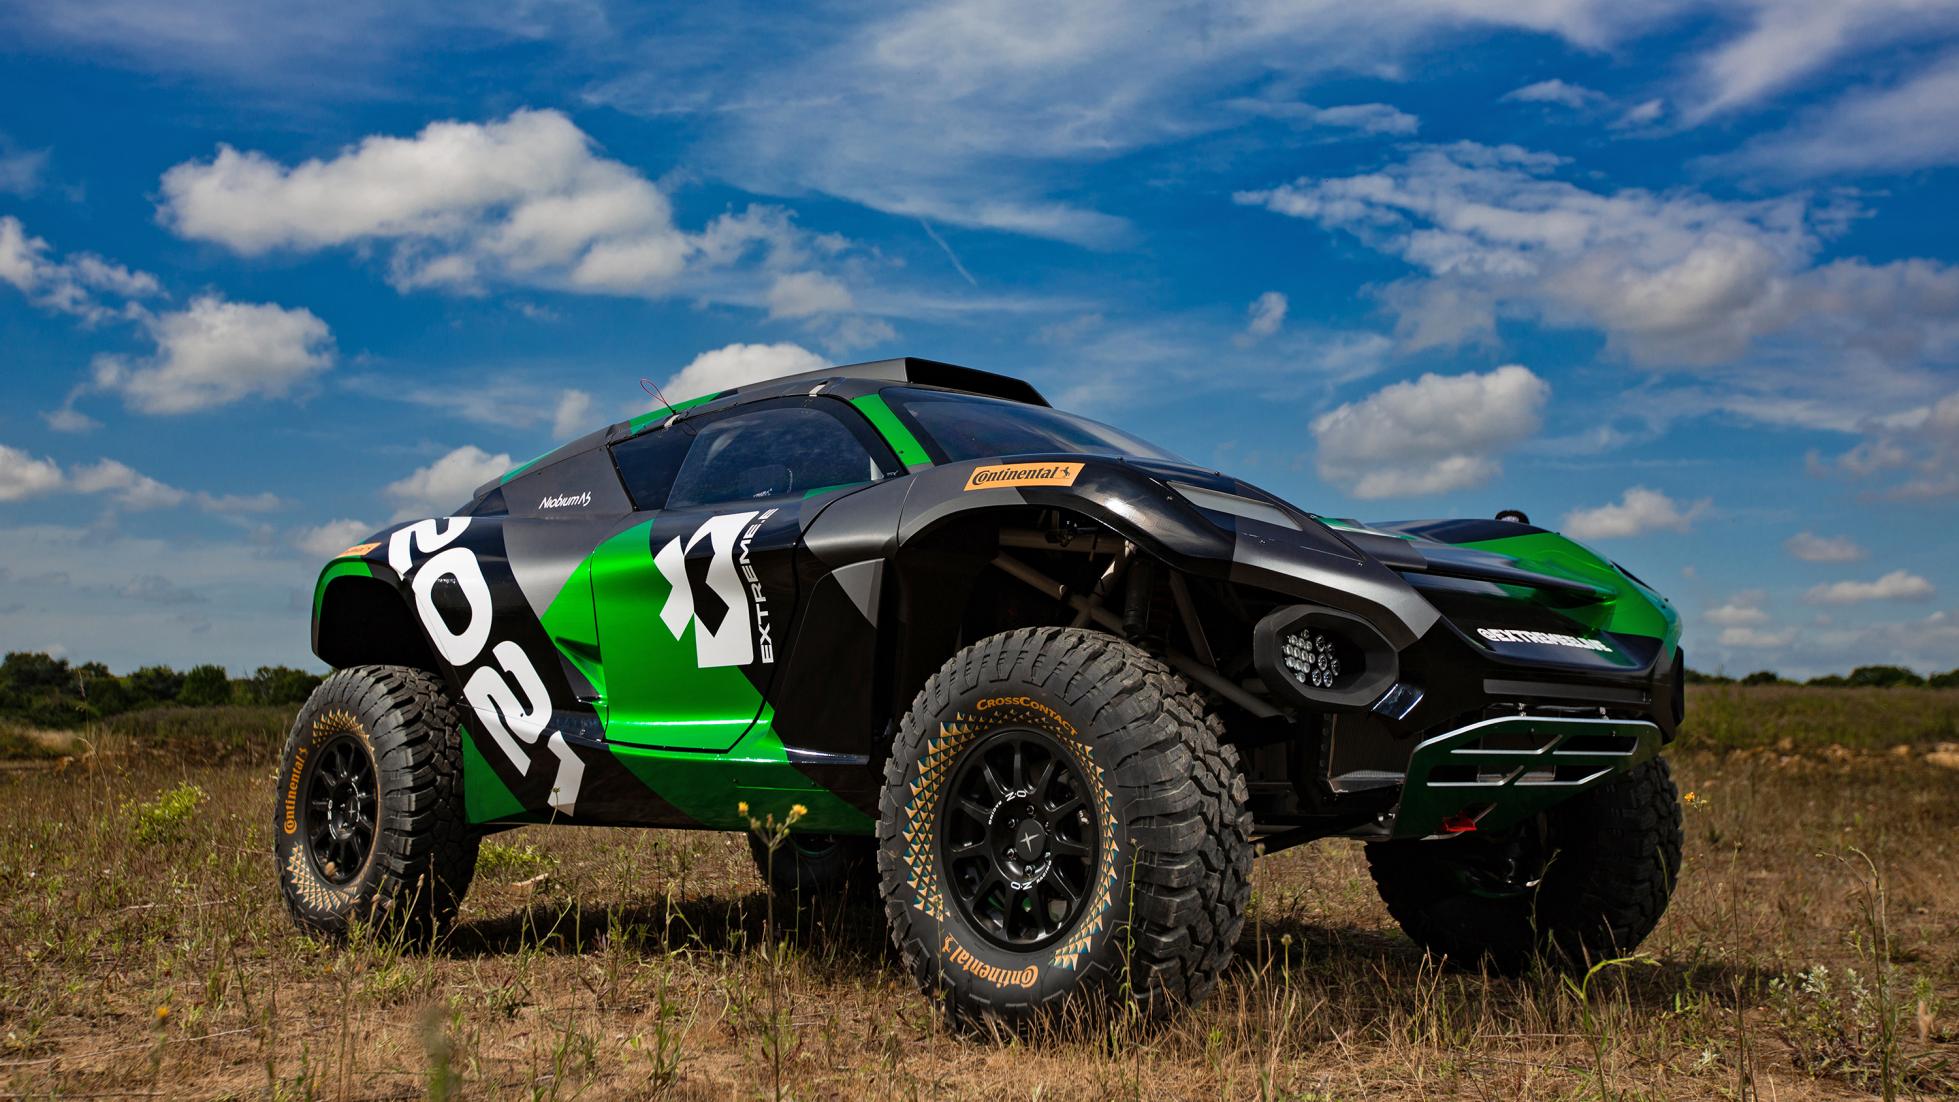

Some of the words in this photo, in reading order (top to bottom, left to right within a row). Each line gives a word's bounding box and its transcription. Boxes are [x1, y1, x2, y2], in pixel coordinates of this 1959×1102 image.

[972, 466, 1060, 486] Continental
[739, 507, 780, 664] EXTREME.E
[284, 752, 306, 835] Continental
[949, 944, 1039, 989] Continental
